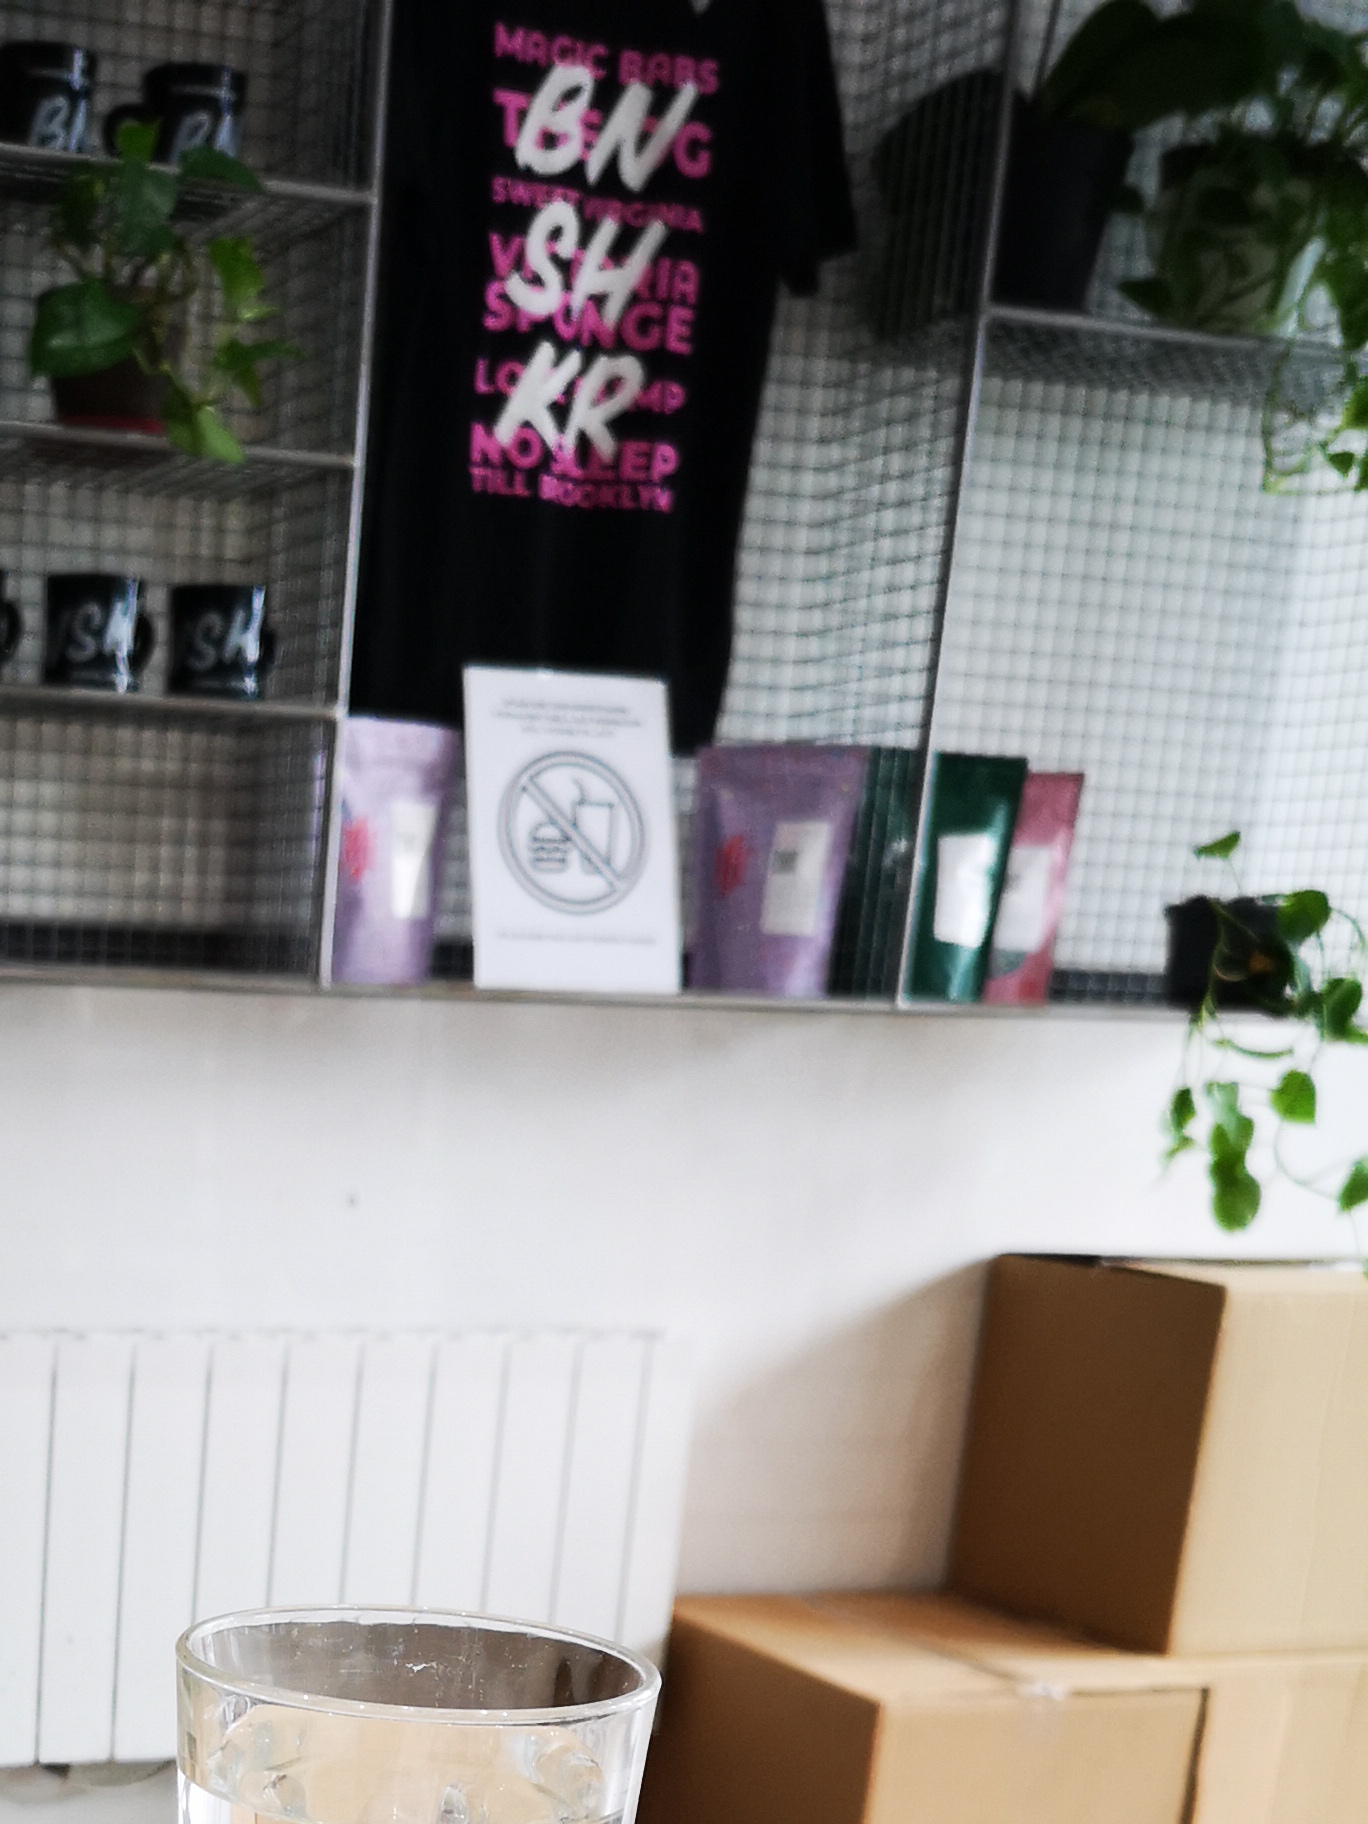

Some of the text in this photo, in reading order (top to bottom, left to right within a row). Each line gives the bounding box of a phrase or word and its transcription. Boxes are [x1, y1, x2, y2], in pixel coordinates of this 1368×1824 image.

[514, 63, 699, 192] BN
[619, 49, 720, 96] BARS
[504, 199, 668, 330] SH
[493, 340, 645, 465] KR
